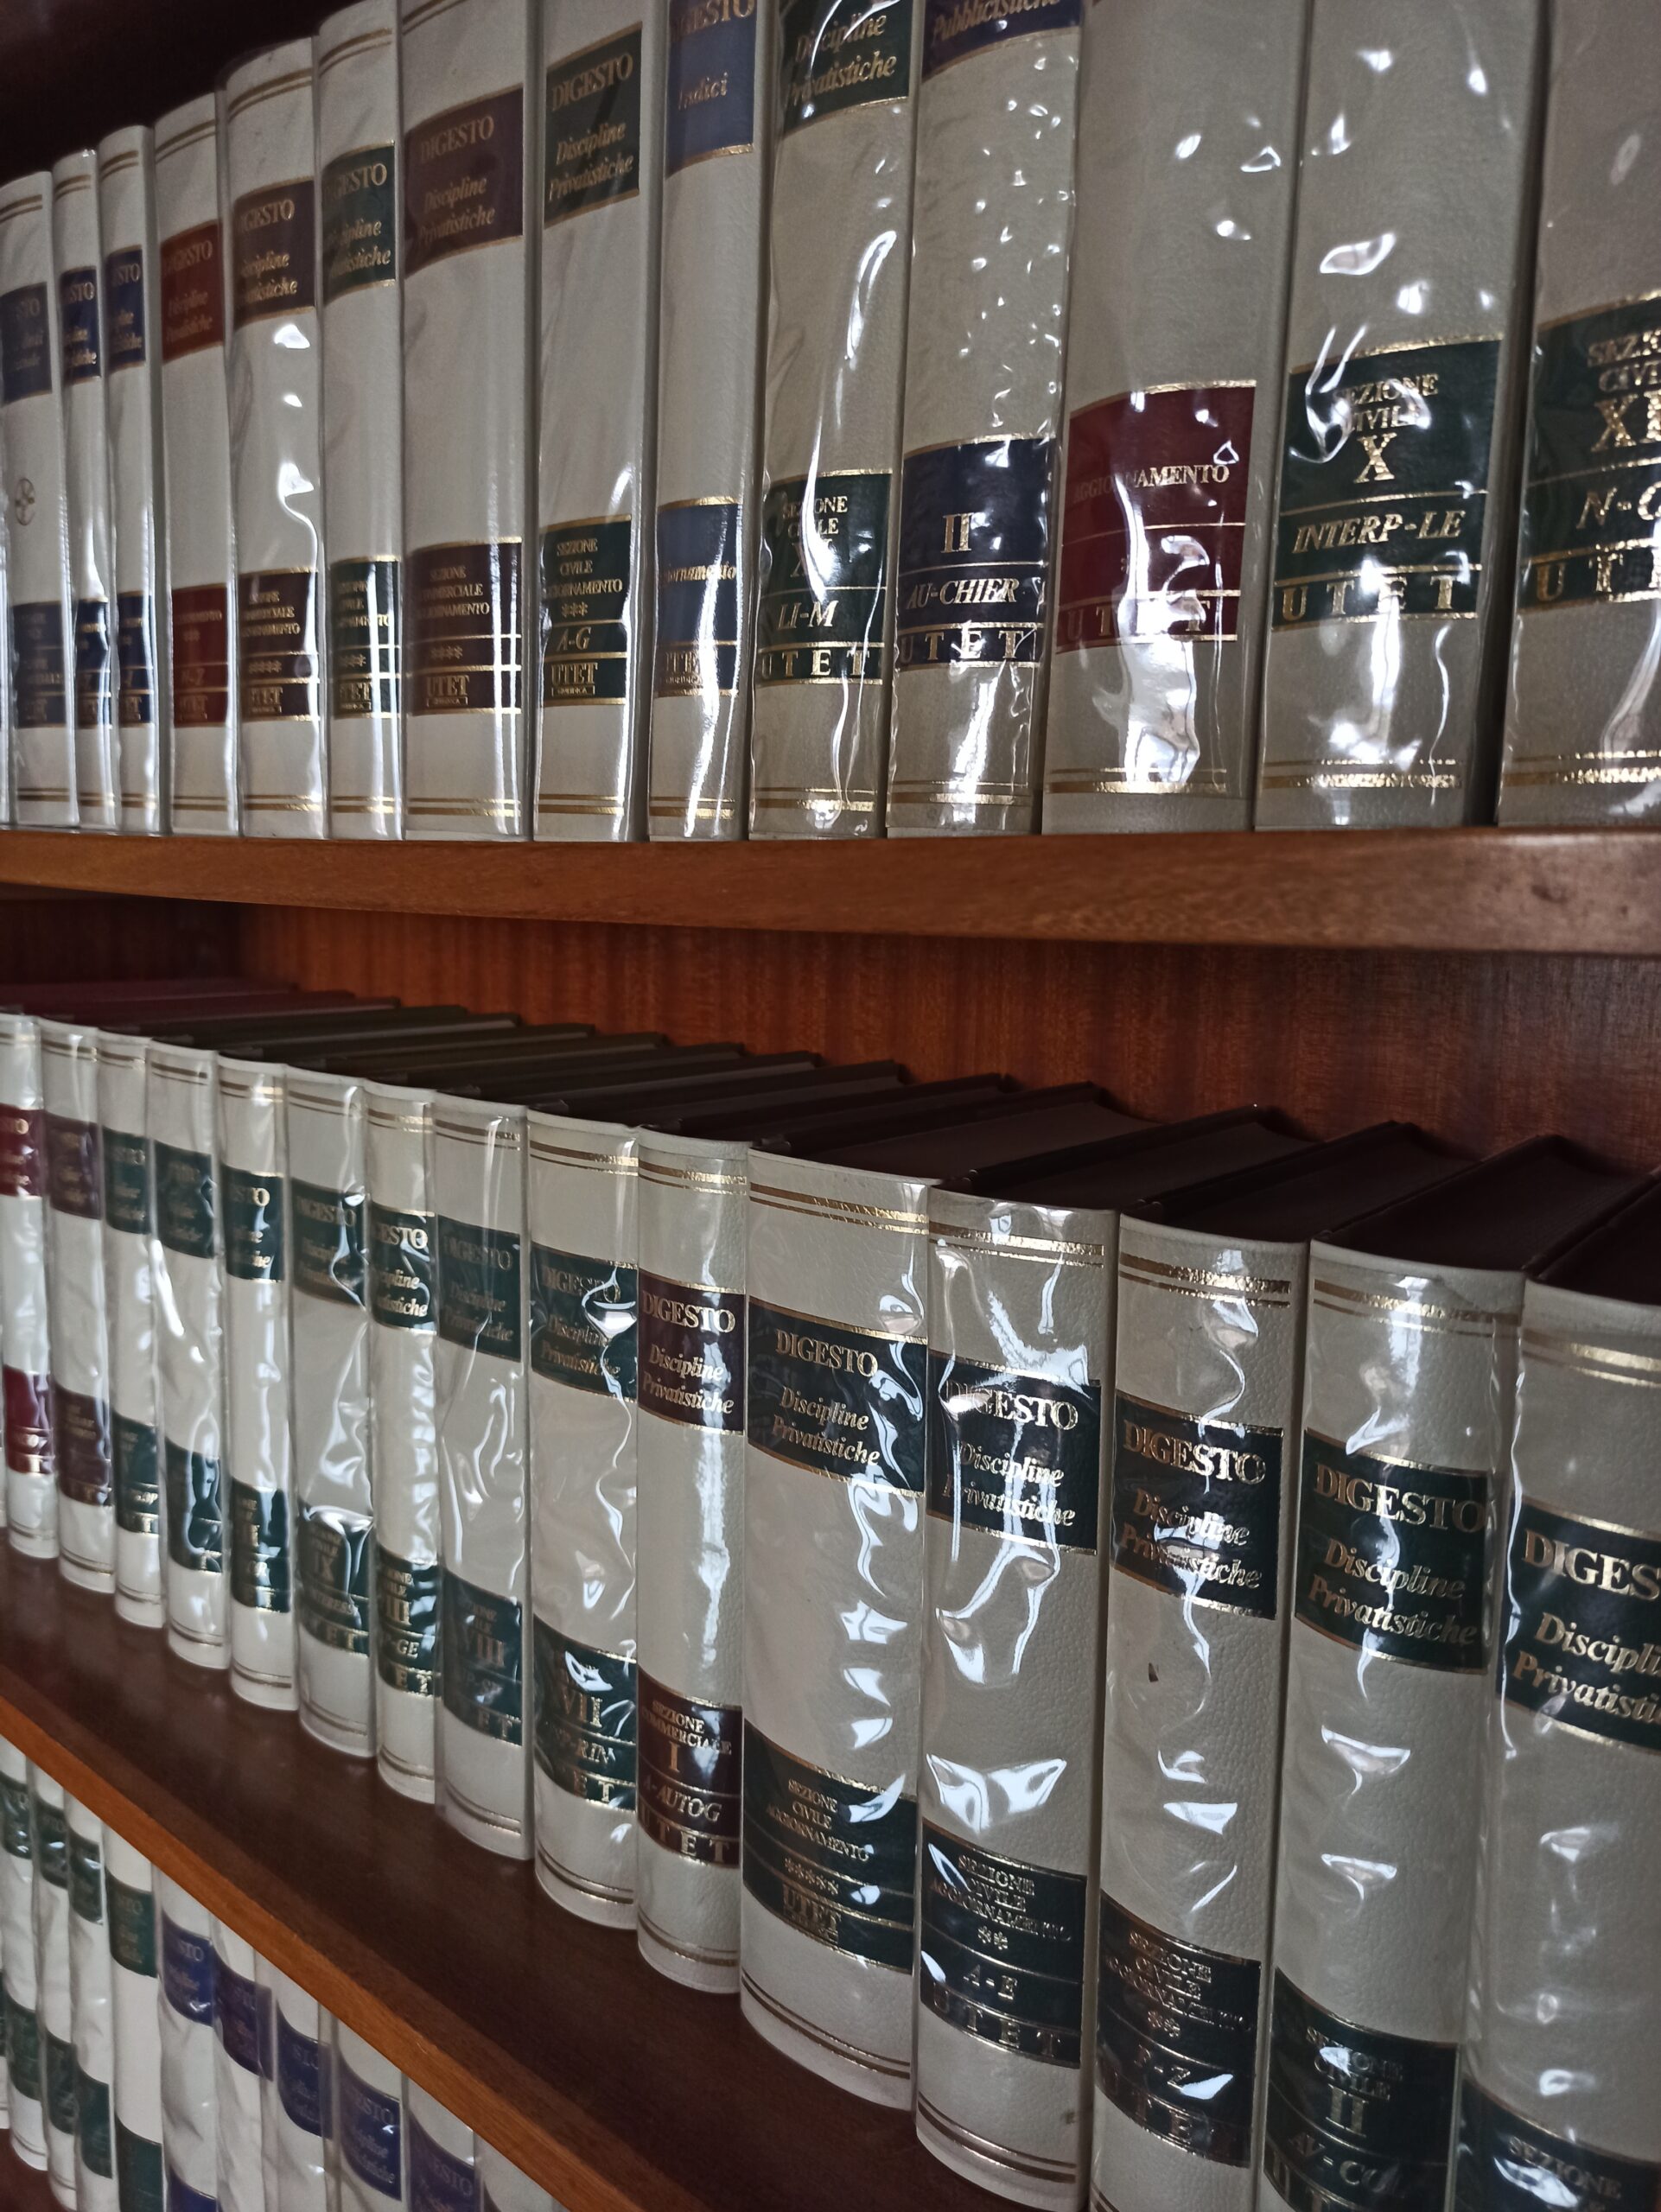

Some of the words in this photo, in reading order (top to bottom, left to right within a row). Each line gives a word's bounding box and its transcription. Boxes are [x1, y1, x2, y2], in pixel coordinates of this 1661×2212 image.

[794, 11, 888, 63] Dicipine
[551, 52, 634, 111] DIGESTO
[556, 121, 627, 165] Discipline
[1353, 433, 1397, 484] X
[557, 537, 598, 556] SEZIONE
[941, 512, 974, 553] II
[1292, 508, 1467, 553] INTERP-LE
[560, 560, 593, 576] CIVILE
[778, 600, 839, 629] LI-M
[907, 577, 1020, 610] AU-CHIER
[557, 626, 592, 652] A-G
[551, 662, 598, 686] UTET
[761, 649, 870, 680] UTET
[640, 1289, 736, 1334] DIGESTO
[648, 1344, 724, 1382] Discipline
[774, 1328, 879, 1378] DIGESTO
[641, 1370, 735, 1414] Privatistiche
[780, 1385, 870, 1431] Discipline
[772, 1414, 881, 1465] Privatistiche
[1123, 1418, 1267, 1485] DIGESTO
[959, 1441, 1065, 1488] Discipline
[1314, 1462, 1486, 1535] DIGESTO
[1323, 1537, 1467, 1599] Discipline
[1522, 1528, 1661, 1603] DIGES
[1308, 1573, 1479, 1643] Privatistiche
[1534, 1611, 1661, 1678] Discipli
[652, 1700, 705, 1734] SEZIONE
[668, 1740, 681, 1773] I
[787, 1778, 838, 1814] SEZIONE
[792, 1801, 833, 1830] CIVILE
[1326, 2082, 1370, 2139] II
